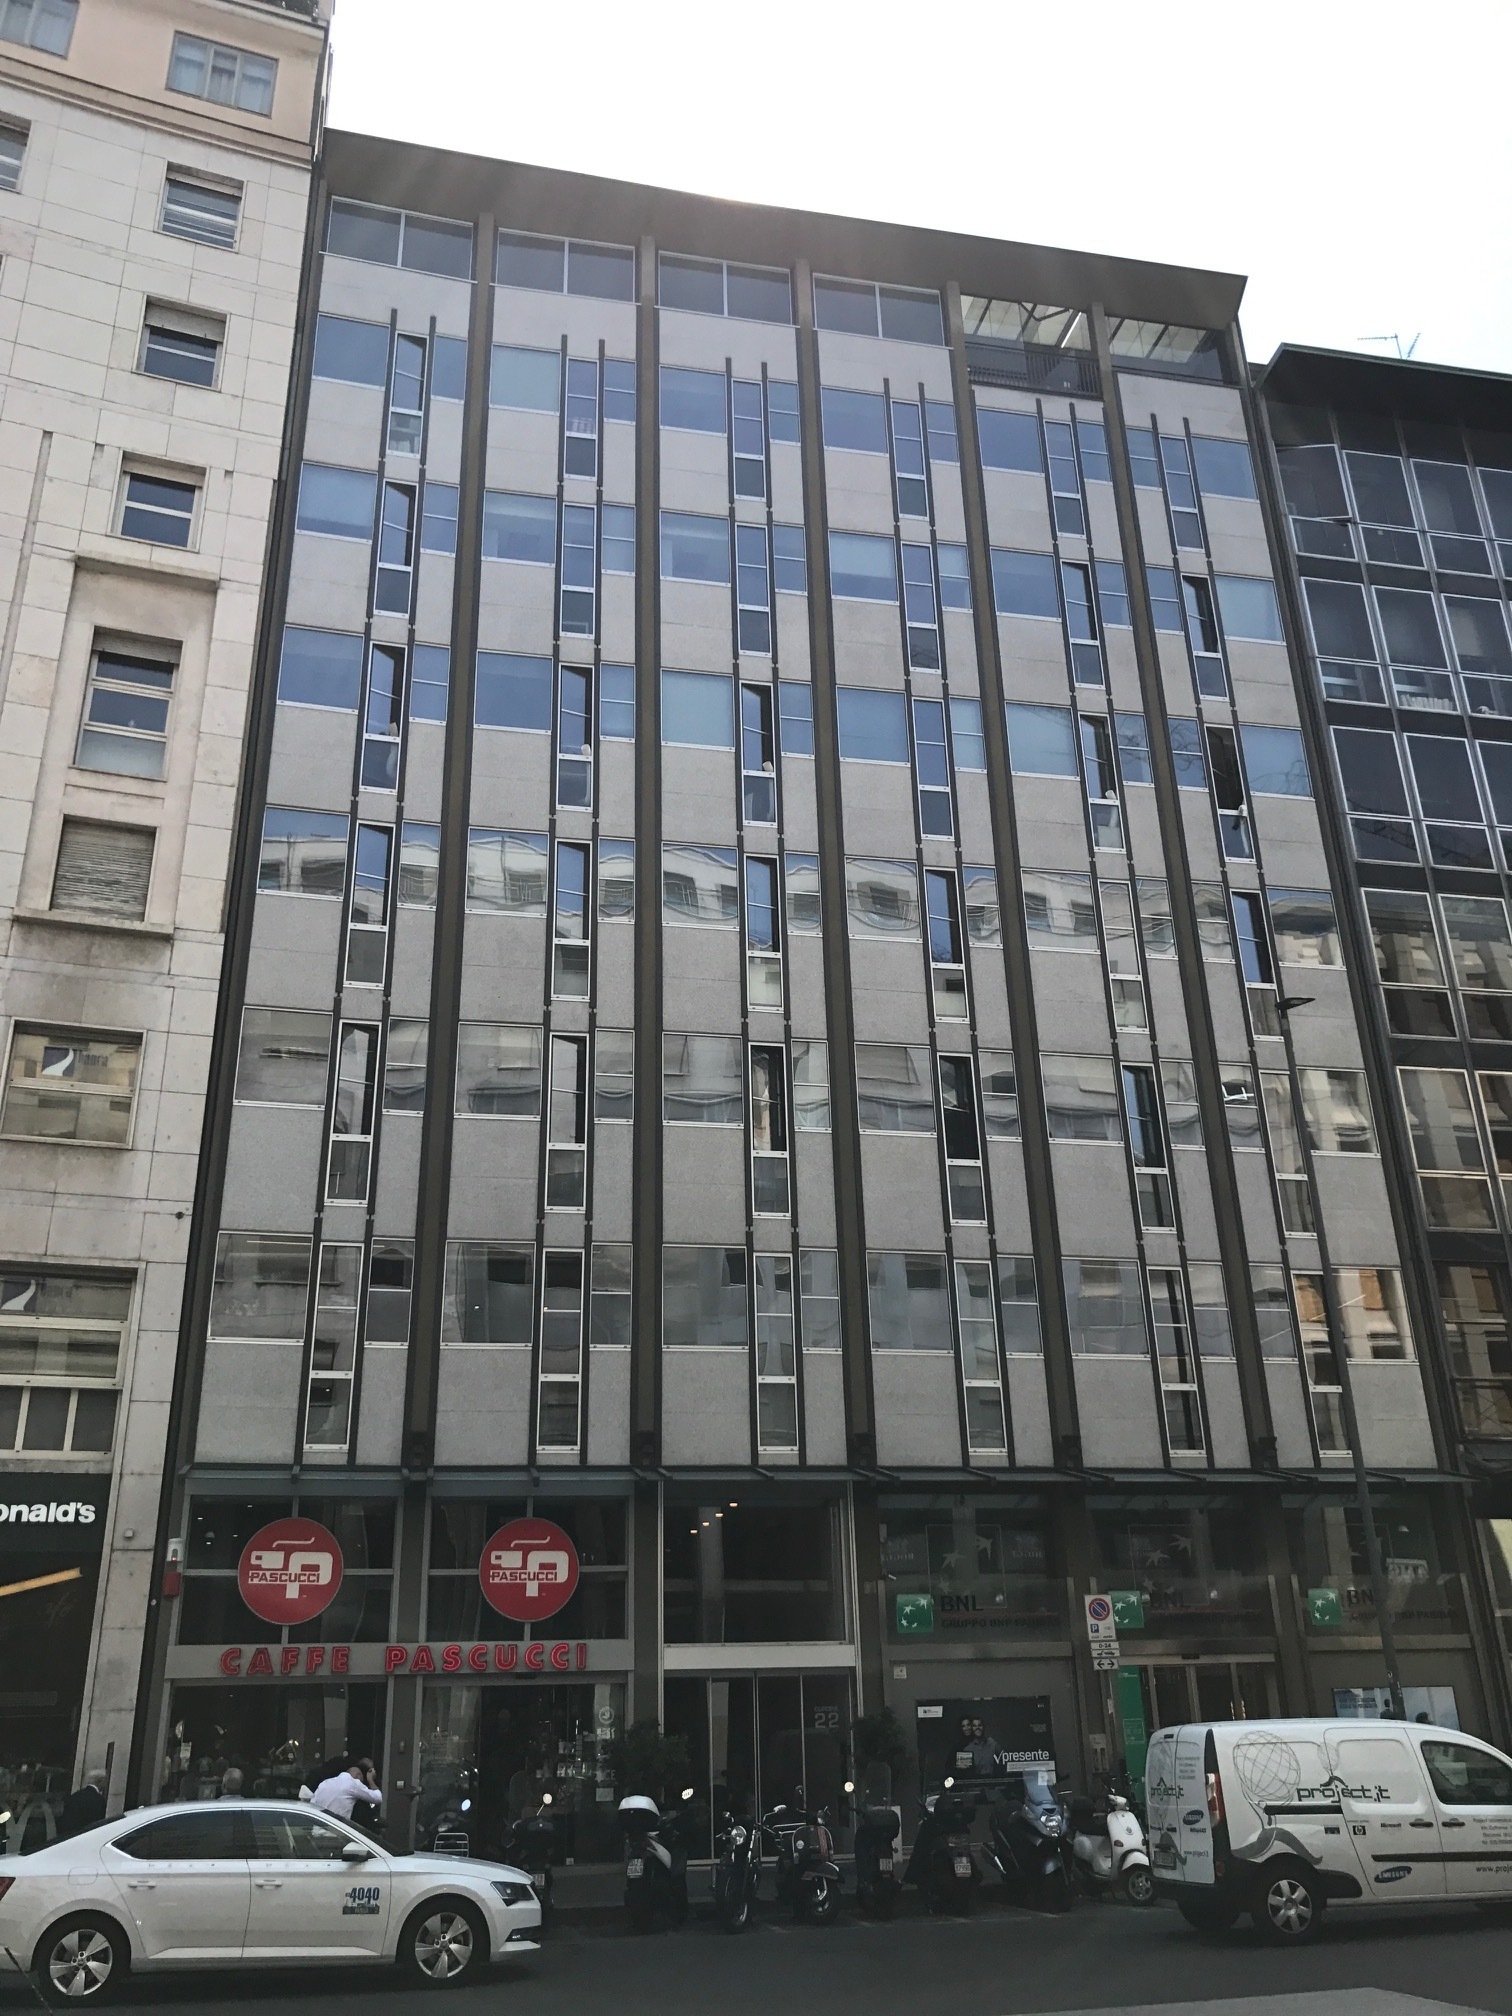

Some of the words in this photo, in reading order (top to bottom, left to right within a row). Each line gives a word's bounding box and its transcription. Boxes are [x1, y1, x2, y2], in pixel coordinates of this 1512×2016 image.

[250, 1572, 320, 1583] PASCUCCI
[491, 1571, 557, 1581] PASCUCCI
[940, 1595, 983, 1612] BNL
[220, 1646, 351, 1676] CAFFE
[385, 1642, 588, 1673] PASCUCCI
[814, 1712, 840, 1728] 22
[1001, 1748, 1050, 1765] presente
[1296, 1785, 1391, 1803] project.it
[350, 1887, 380, 1904] 4040
